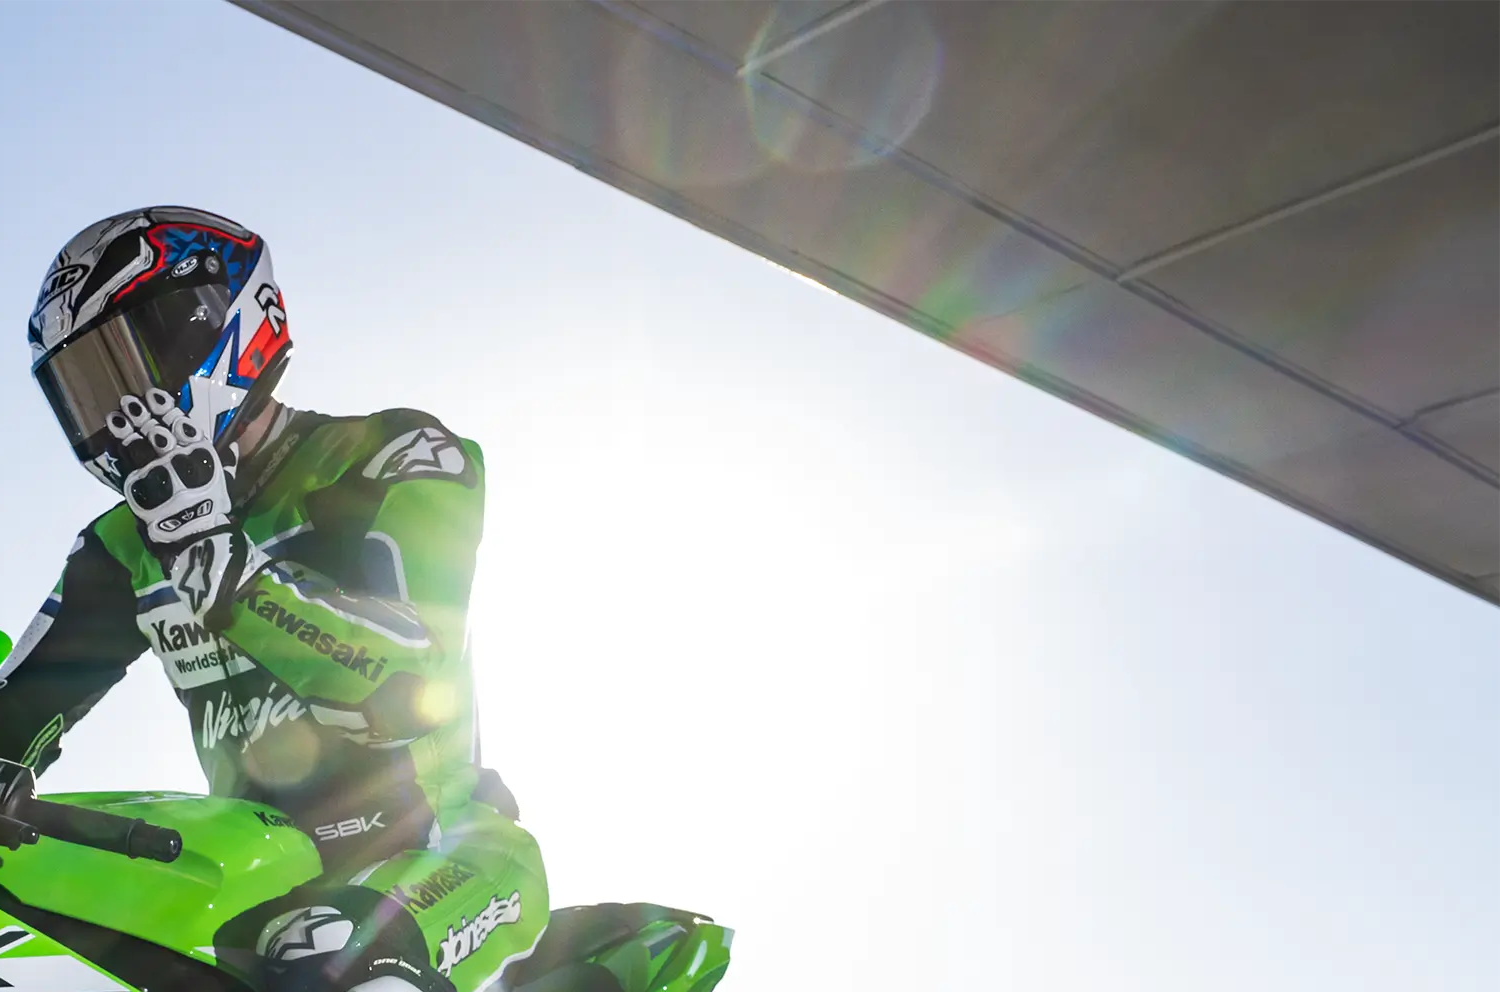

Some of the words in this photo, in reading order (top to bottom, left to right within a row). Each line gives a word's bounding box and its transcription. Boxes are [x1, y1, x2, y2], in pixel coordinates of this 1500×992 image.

[175, 259, 196, 275] HJC
[150, 619, 211, 654] Kaw
[237, 588, 389, 683] Kawasaki
[202, 682, 307, 754] Ninja
[314, 811, 386, 842] SBK
